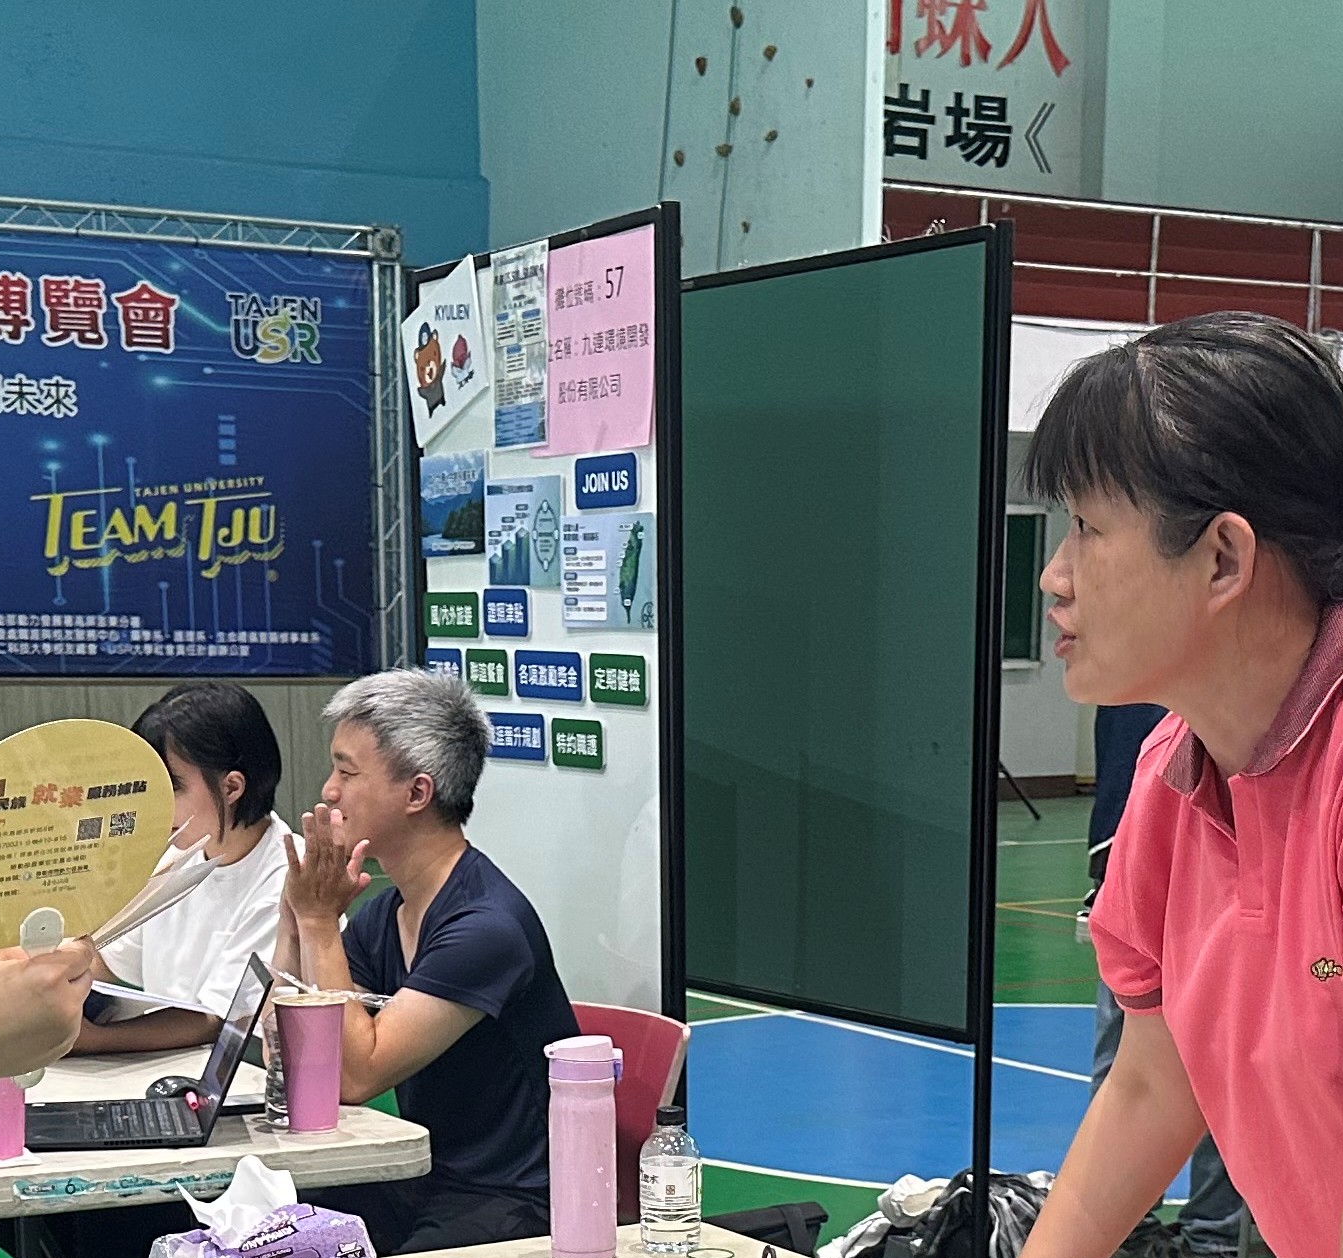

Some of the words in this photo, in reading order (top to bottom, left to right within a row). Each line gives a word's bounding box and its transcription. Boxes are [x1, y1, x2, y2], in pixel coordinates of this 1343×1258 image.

[226, 292, 322, 323] TAJEN
[230, 312, 323, 364] USR
[582, 473, 607, 494] JOIN
[612, 470, 629, 490] US
[30, 487, 178, 559] TEAM
[184, 492, 276, 561] TJU
